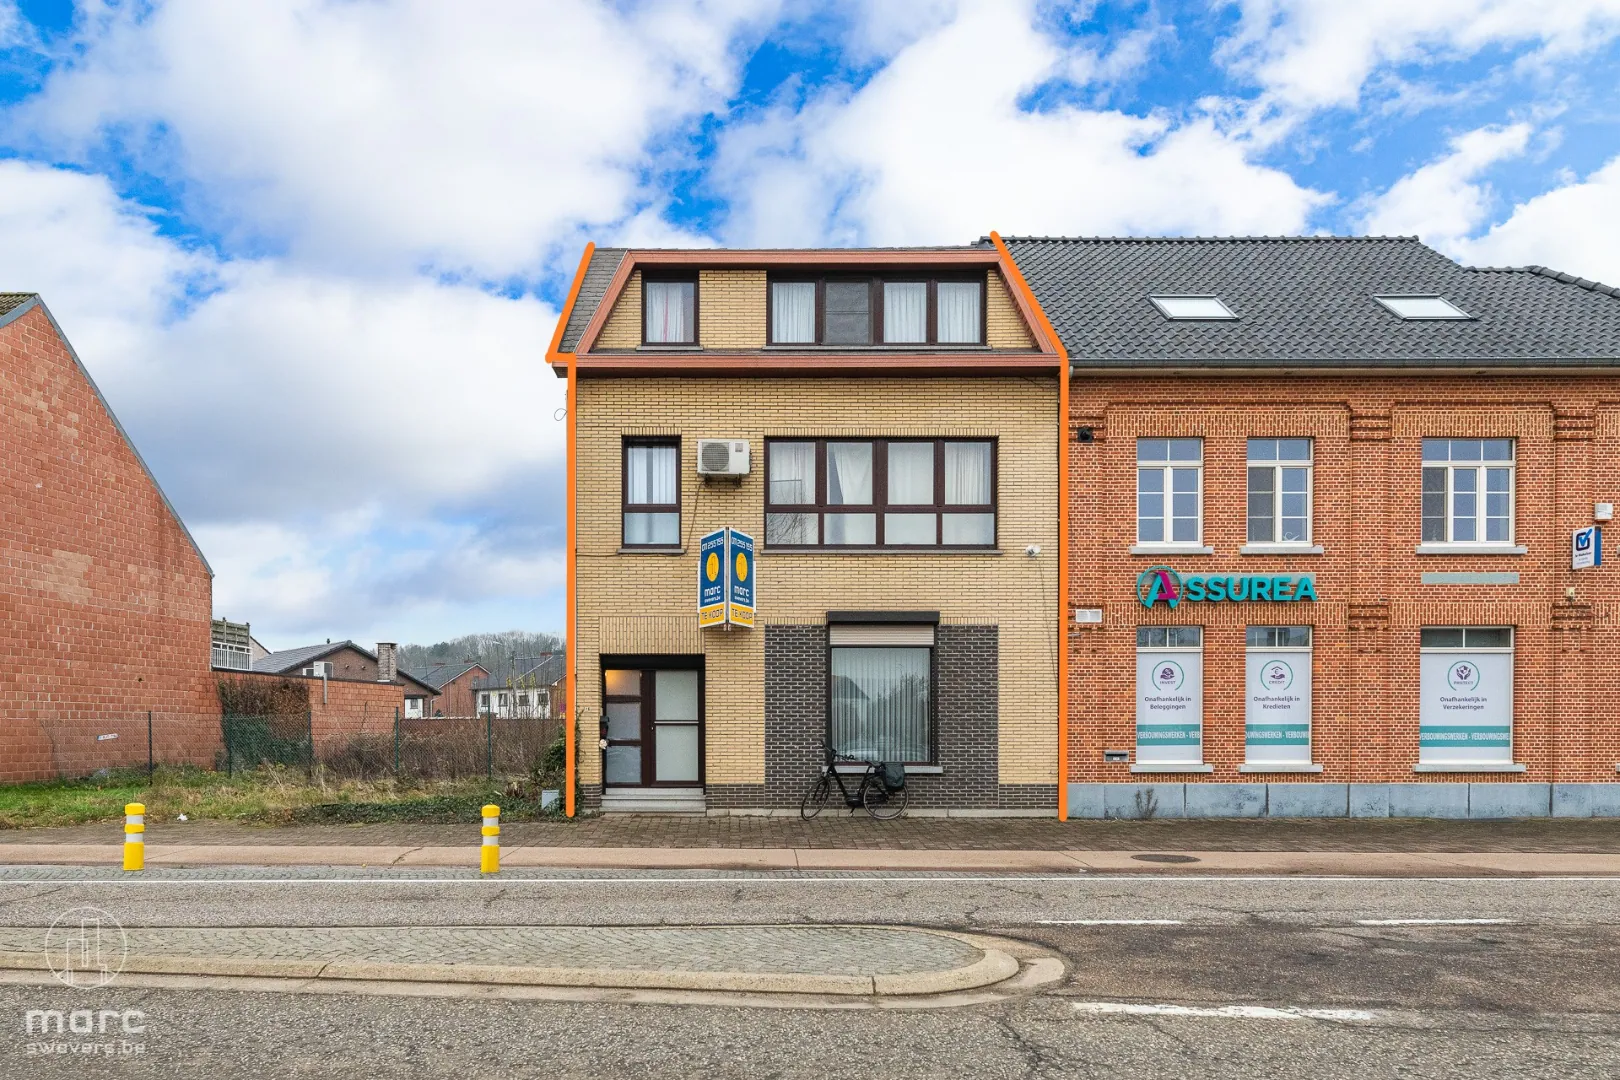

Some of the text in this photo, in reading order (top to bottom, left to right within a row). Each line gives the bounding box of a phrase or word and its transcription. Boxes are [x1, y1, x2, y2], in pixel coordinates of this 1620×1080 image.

[704, 586, 721, 597] marc
[734, 585, 750, 597] marc
[1144, 570, 1317, 609] ASSUREA
[701, 608, 724, 620] TE KOOP
[731, 608, 753, 620] TE KOOP
[1440, 696, 1480, 704] Onafhankelijk
